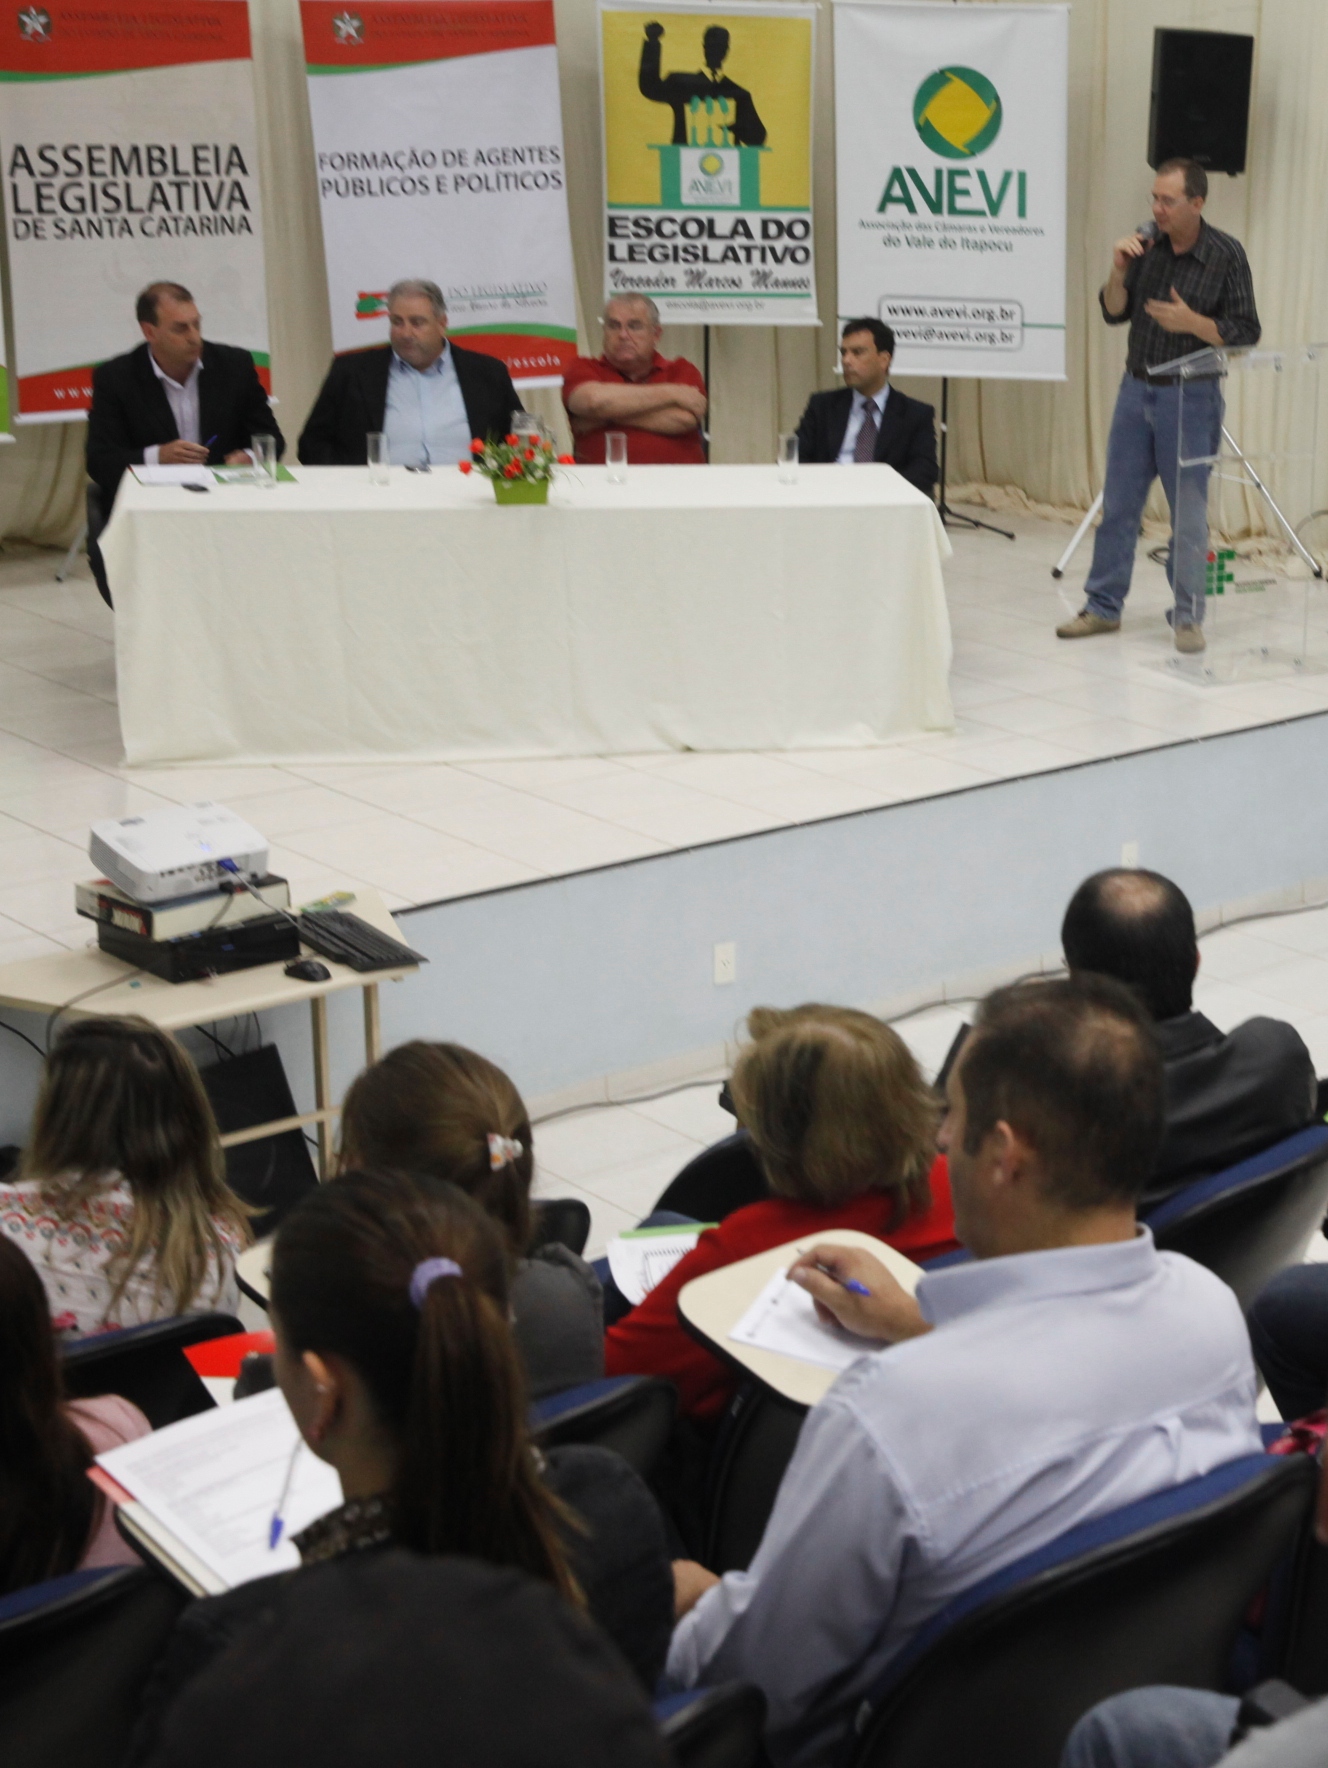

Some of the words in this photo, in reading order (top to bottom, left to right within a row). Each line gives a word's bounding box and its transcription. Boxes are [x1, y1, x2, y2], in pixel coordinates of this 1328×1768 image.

[8, 143, 248, 178] ASSEMBLEIA
[318, 147, 437, 172] FORMAÇÃO
[442, 150, 469, 169] DE
[474, 146, 561, 166] AGENTES
[11, 179, 250, 214] LEGISLATIVA
[320, 173, 430, 199] PÚBLICOS
[436, 174, 448, 195] E
[453, 169, 563, 193] POLÍTICOS
[876, 165, 1027, 219] AVEVI
[13, 217, 47, 240] DE
[53, 216, 134, 240] SANTA
[139, 213, 253, 238] CATARINA
[607, 215, 755, 240] ESCOLA
[760, 218, 811, 241] DO
[607, 243, 812, 265] LEGISLATIVO
[904, 233, 935, 249] Vale
[886, 304, 1016, 322] www.avevi.org.br
[893, 326, 1015, 345] vevi@avevi.org.br
